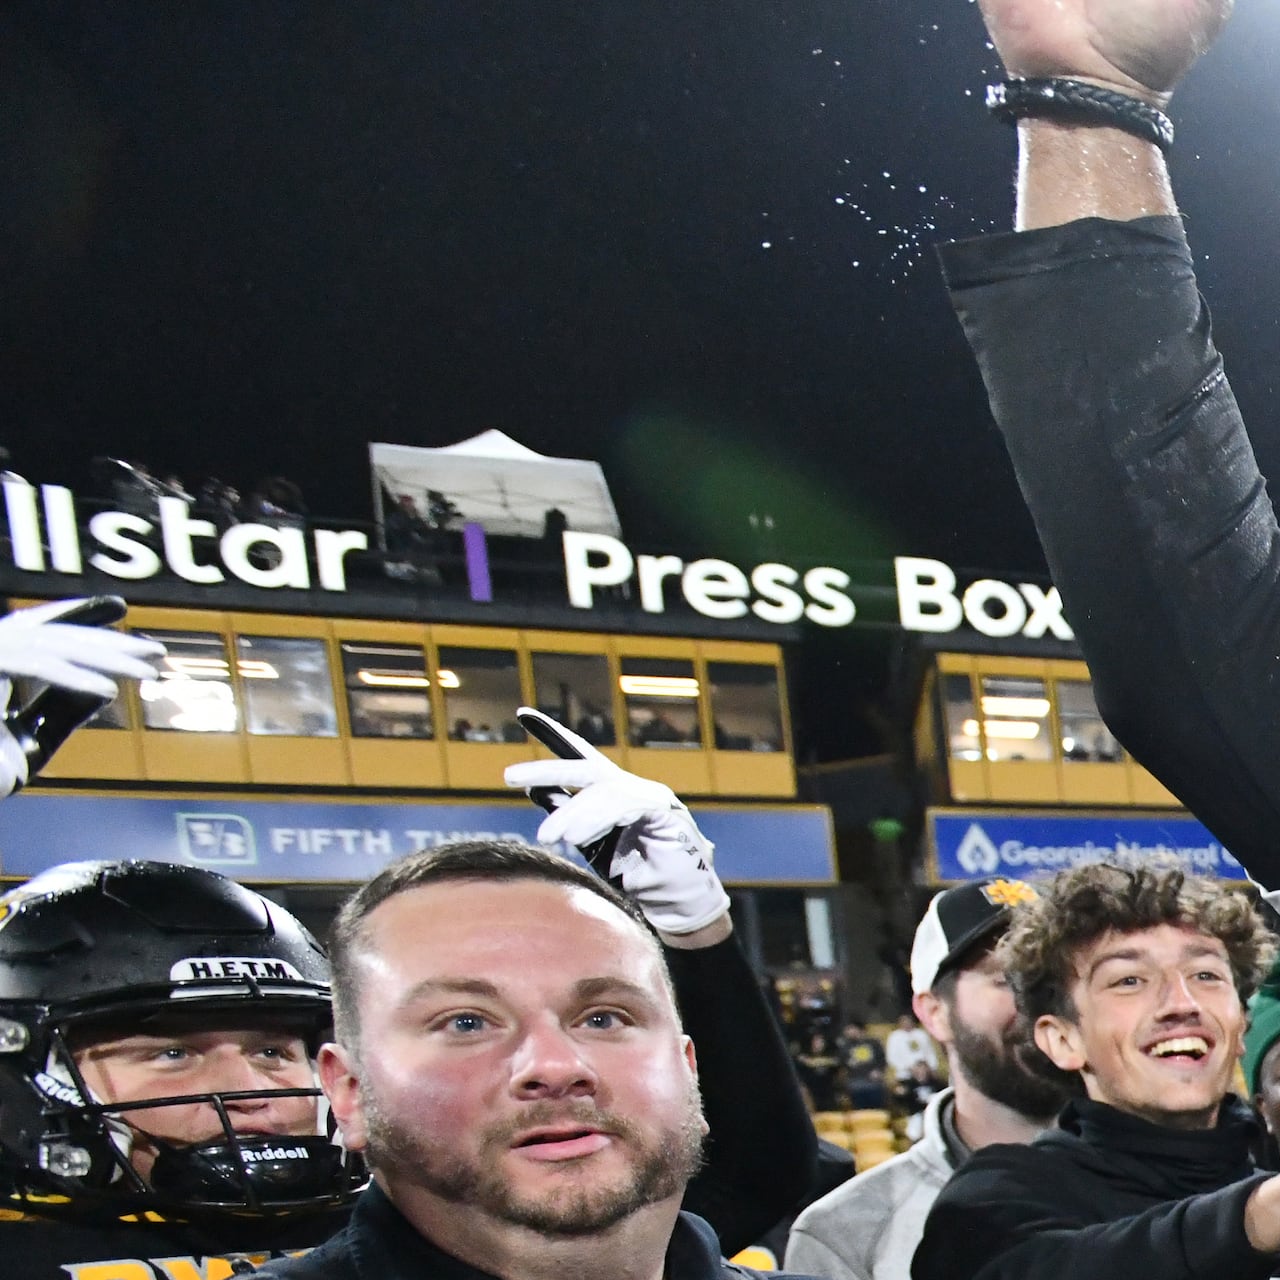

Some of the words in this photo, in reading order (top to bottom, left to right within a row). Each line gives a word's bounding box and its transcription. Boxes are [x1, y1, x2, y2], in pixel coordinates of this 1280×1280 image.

[562, 531, 856, 628] Press
[895, 556, 1074, 641] Box
[269, 827, 394, 855] FIFTH
[241, 1147, 309, 1163] Riddell
